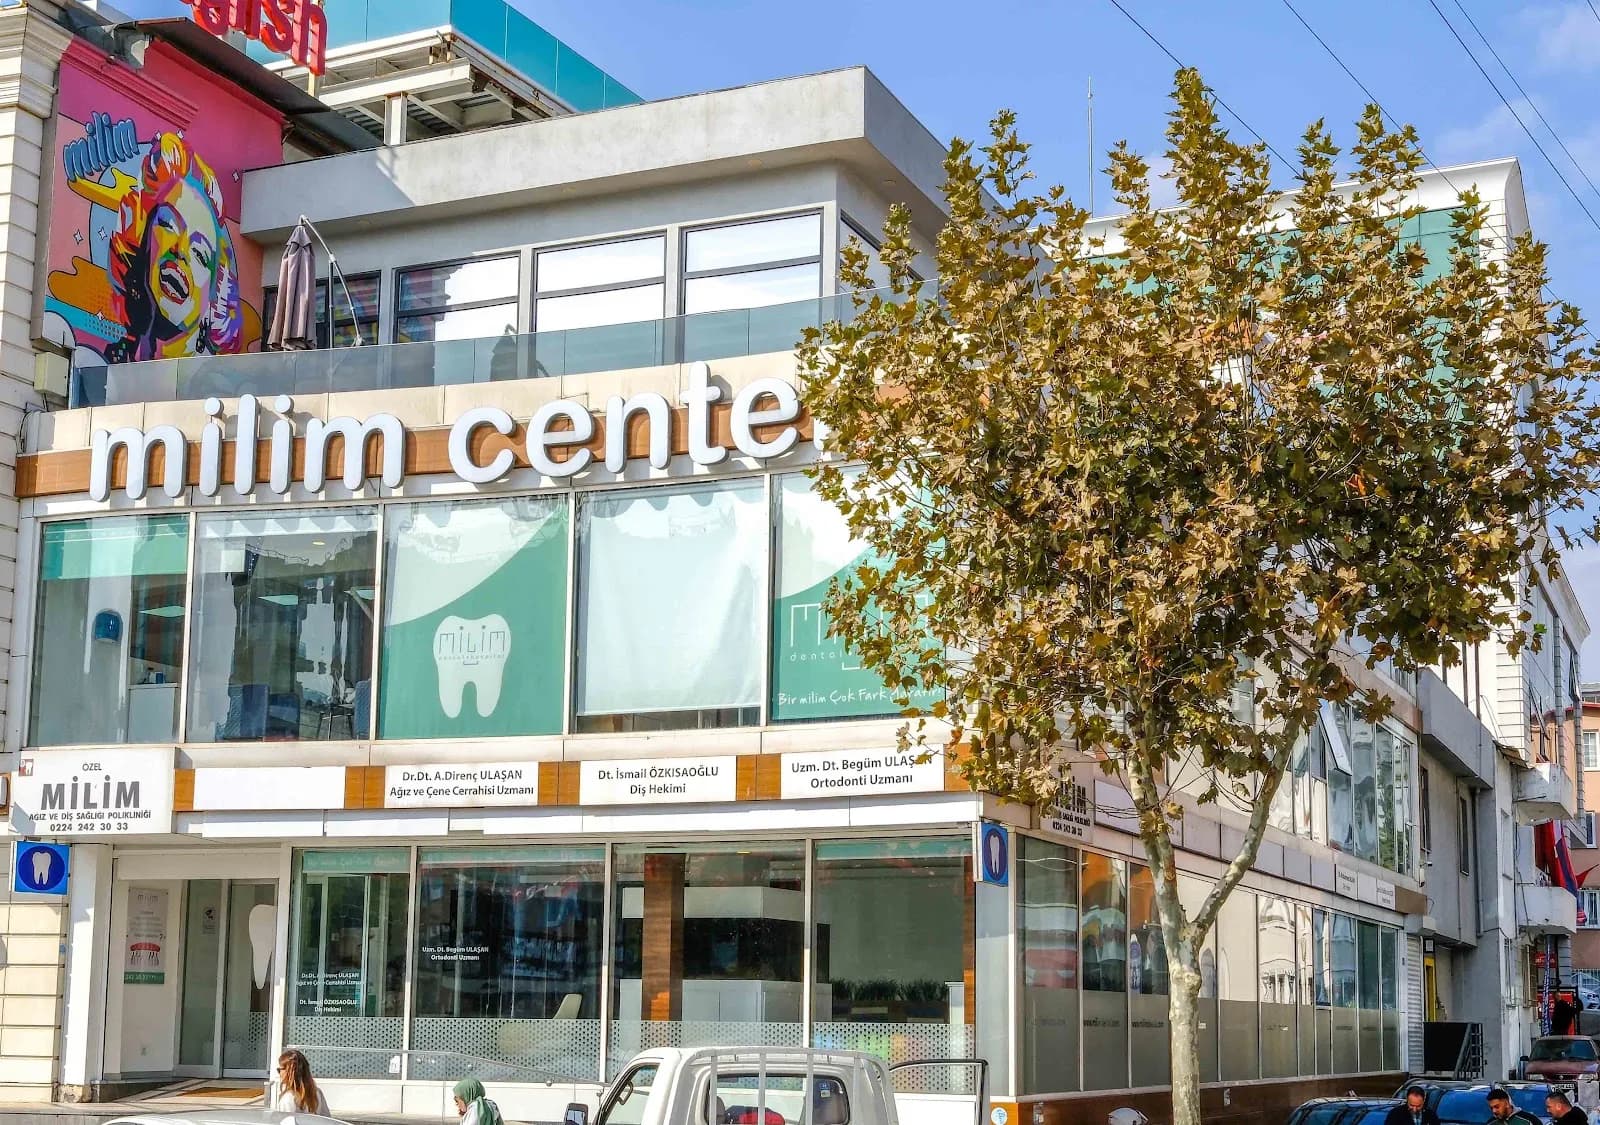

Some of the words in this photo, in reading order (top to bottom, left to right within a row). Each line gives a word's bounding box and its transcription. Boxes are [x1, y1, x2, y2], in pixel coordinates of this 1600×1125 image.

[63, 111, 140, 182] milim
[89, 393, 404, 502] milim
[778, 692, 796, 705] Bir
[800, 690, 827, 704] milim
[858, 687, 888, 702] Fark
[791, 762, 820, 773] Uzm.
[822, 760, 839, 771] Dt.
[841, 758, 882, 771] Begüm
[884, 754, 933, 769] ULAŞN
[402, 771, 432, 781] Dr.Dt.
[434, 770, 477, 783] A.Direnç
[480, 769, 523, 782] ULAŞAN
[598, 770, 614, 780] Dt.
[616, 767, 647, 779] İsmail
[649, 764, 719, 778] ÖZKISAOĞLU
[810, 775, 867, 789] Ortodonti
[869, 774, 913, 785] Uzmanı
[41, 775, 140, 811] MİLİM
[389, 786, 411, 798] Ağız
[413, 788, 425, 796] ve
[426, 786, 451, 798] Çene
[452, 785, 495, 796] Cerrahisi
[497, 785, 534, 795] Uzmanı
[630, 784, 646, 797] Diş
[649, 783, 686, 794] Hekimi
[49, 812, 59, 821] VE
[50, 823, 73, 832] 0224
[77, 822, 95, 832] 242
[100, 822, 112, 832] 30
[116, 821, 129, 831] 33
